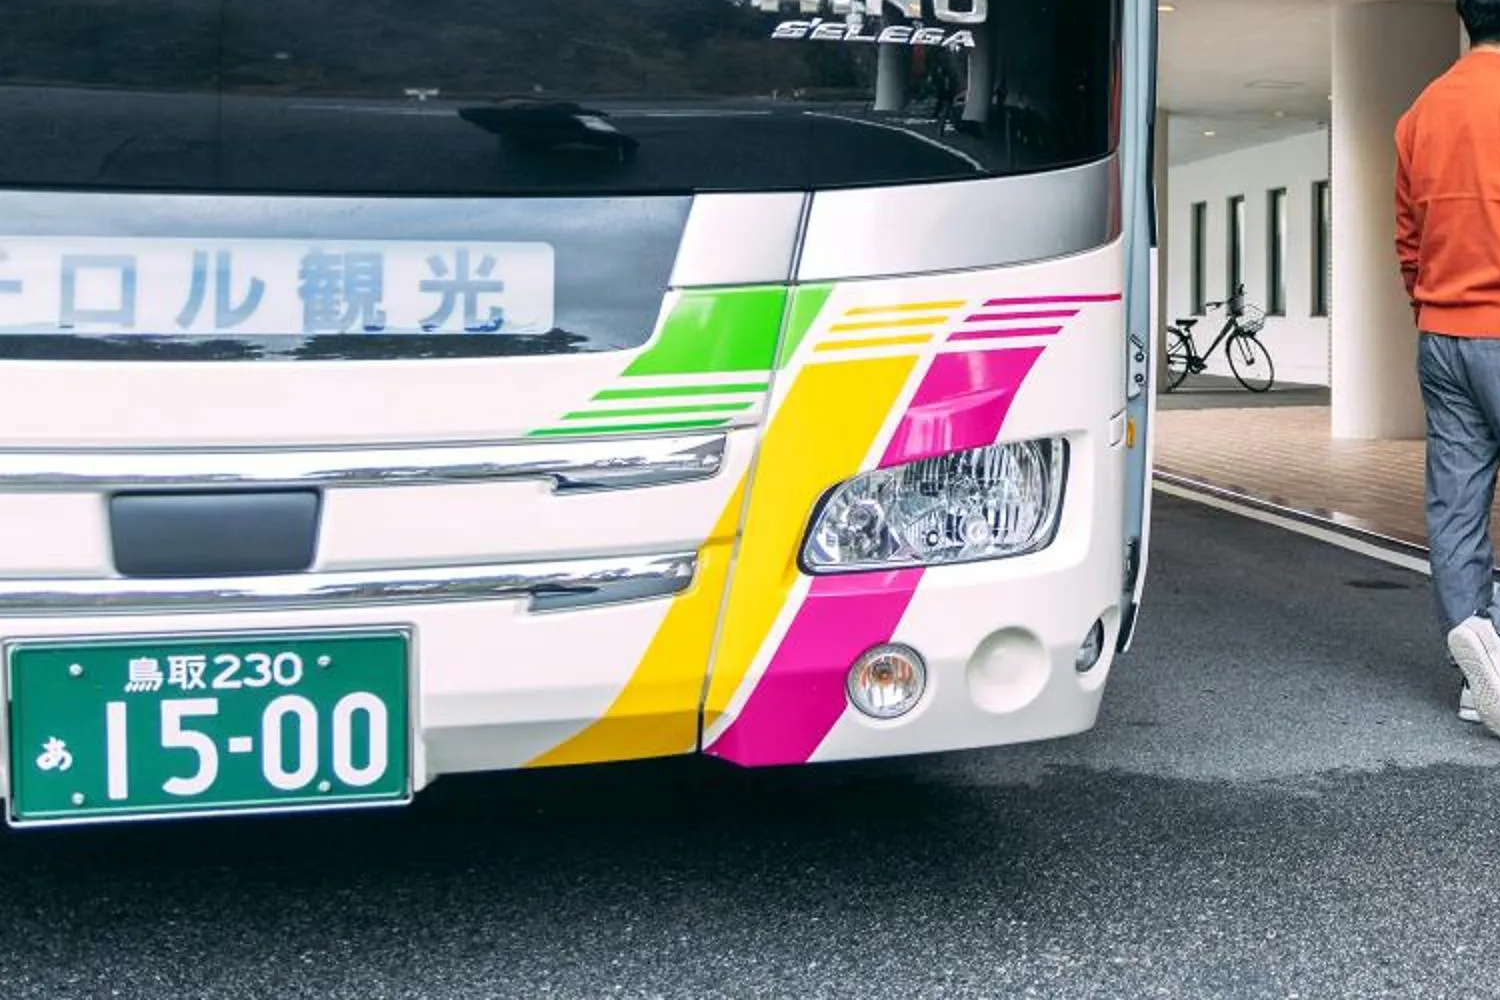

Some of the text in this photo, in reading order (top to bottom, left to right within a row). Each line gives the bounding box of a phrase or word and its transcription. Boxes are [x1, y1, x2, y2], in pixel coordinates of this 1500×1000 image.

[771, 18, 976, 48] SELEGA
[36, 691, 389, 800] あ 15-00
